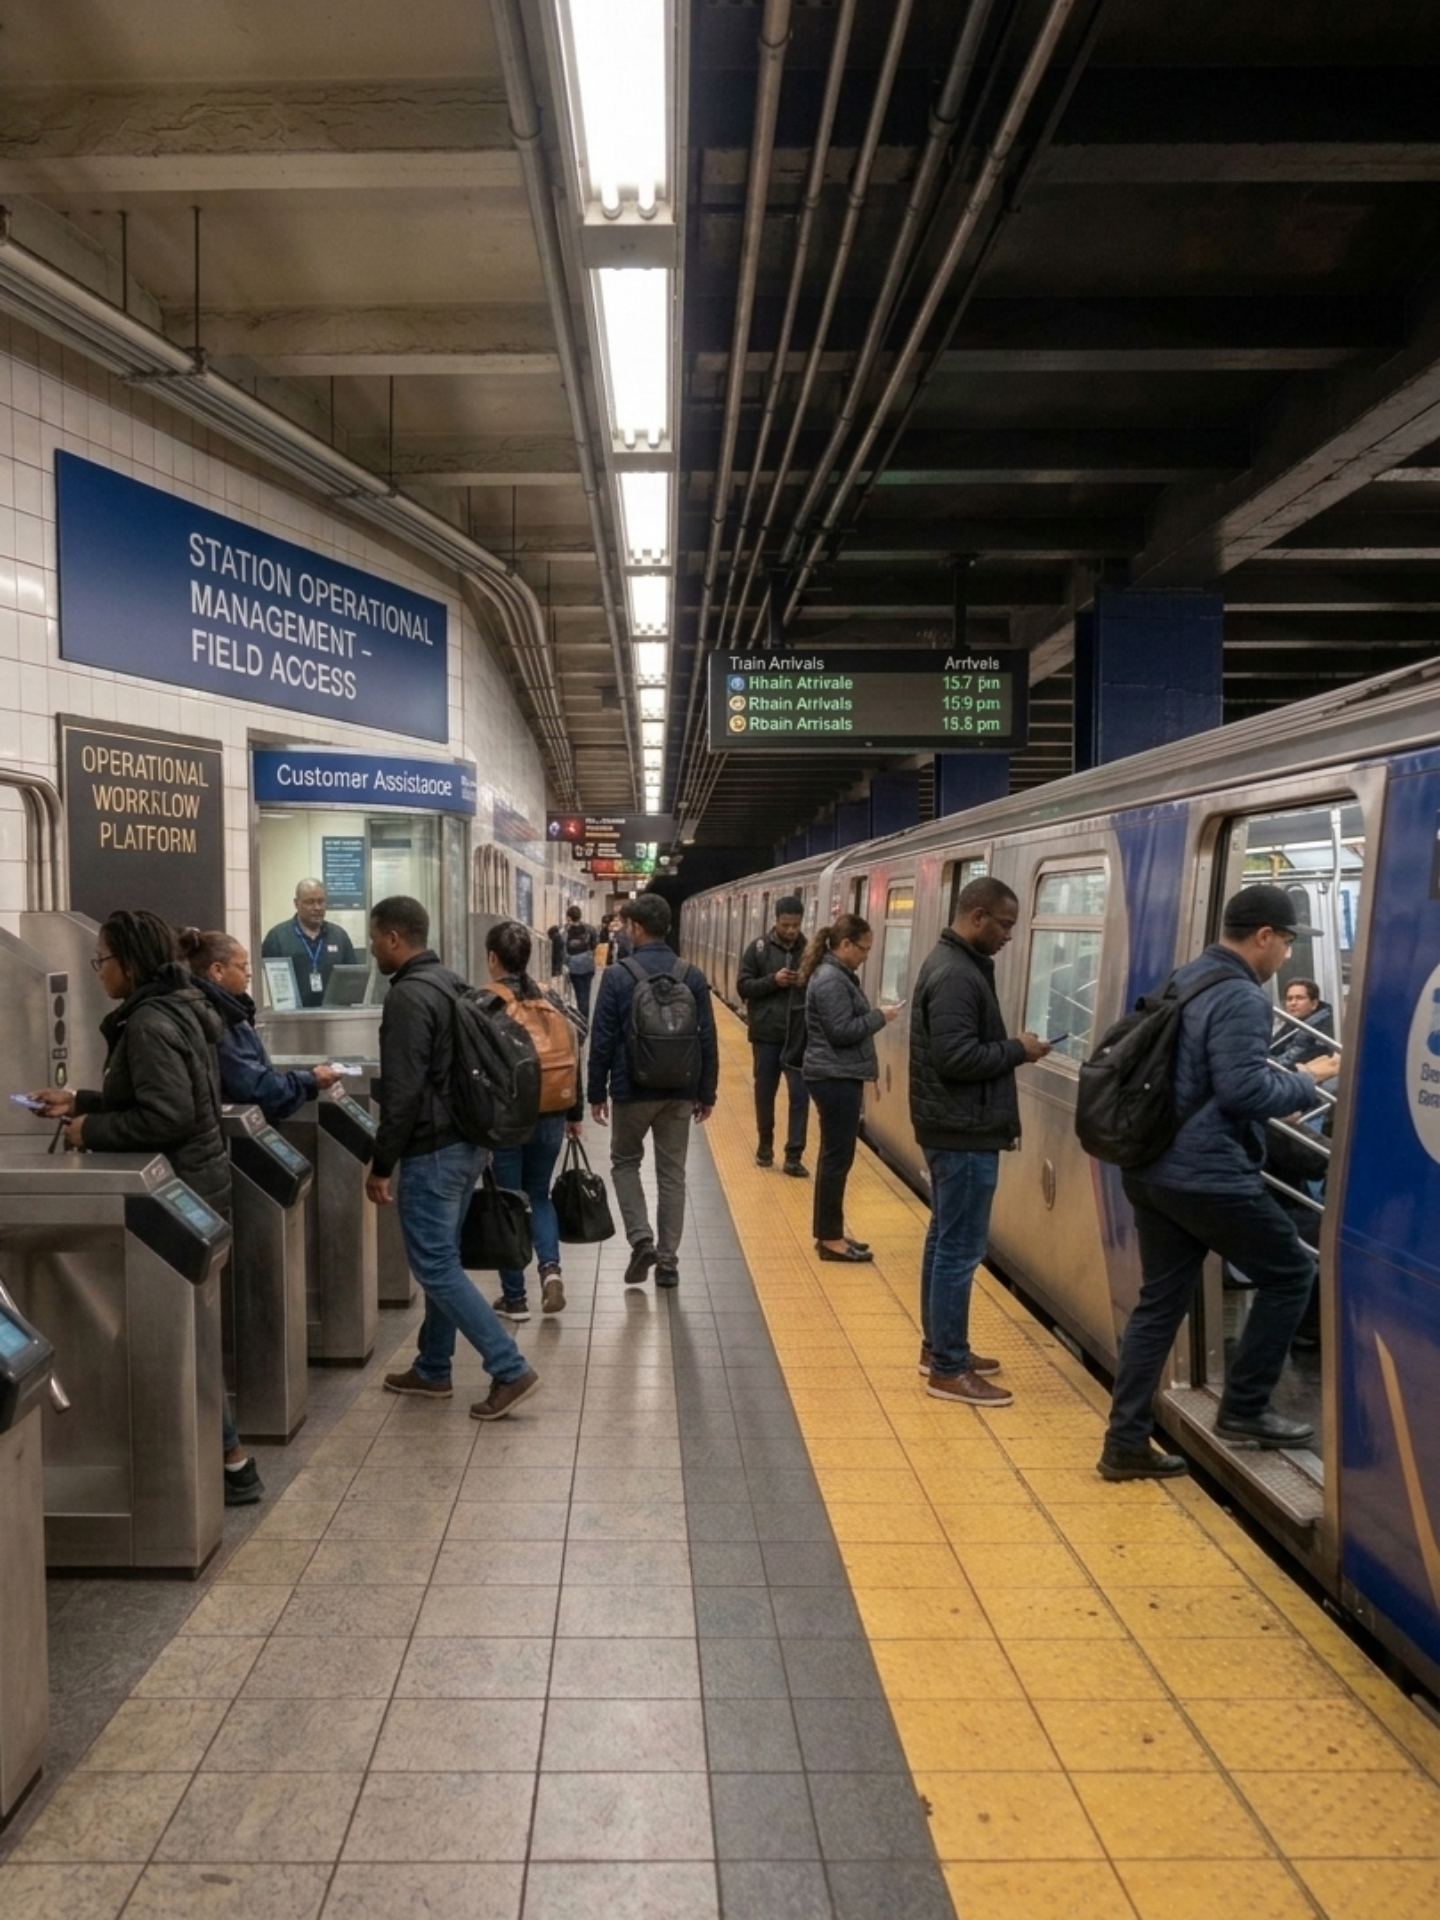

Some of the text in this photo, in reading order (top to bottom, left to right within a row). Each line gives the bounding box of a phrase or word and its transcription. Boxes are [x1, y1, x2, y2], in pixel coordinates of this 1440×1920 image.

[189, 532, 434, 645] STATION OPERATIONAL
[190, 580, 357, 659] MANAGEMENT
[192, 629, 357, 700] FIELD ACCESS
[976, 699, 1001, 713] pm
[976, 719, 1001, 734] pm
[82, 745, 209, 787] OPERATIONAL
[101, 822, 197, 853] PLATFORM
